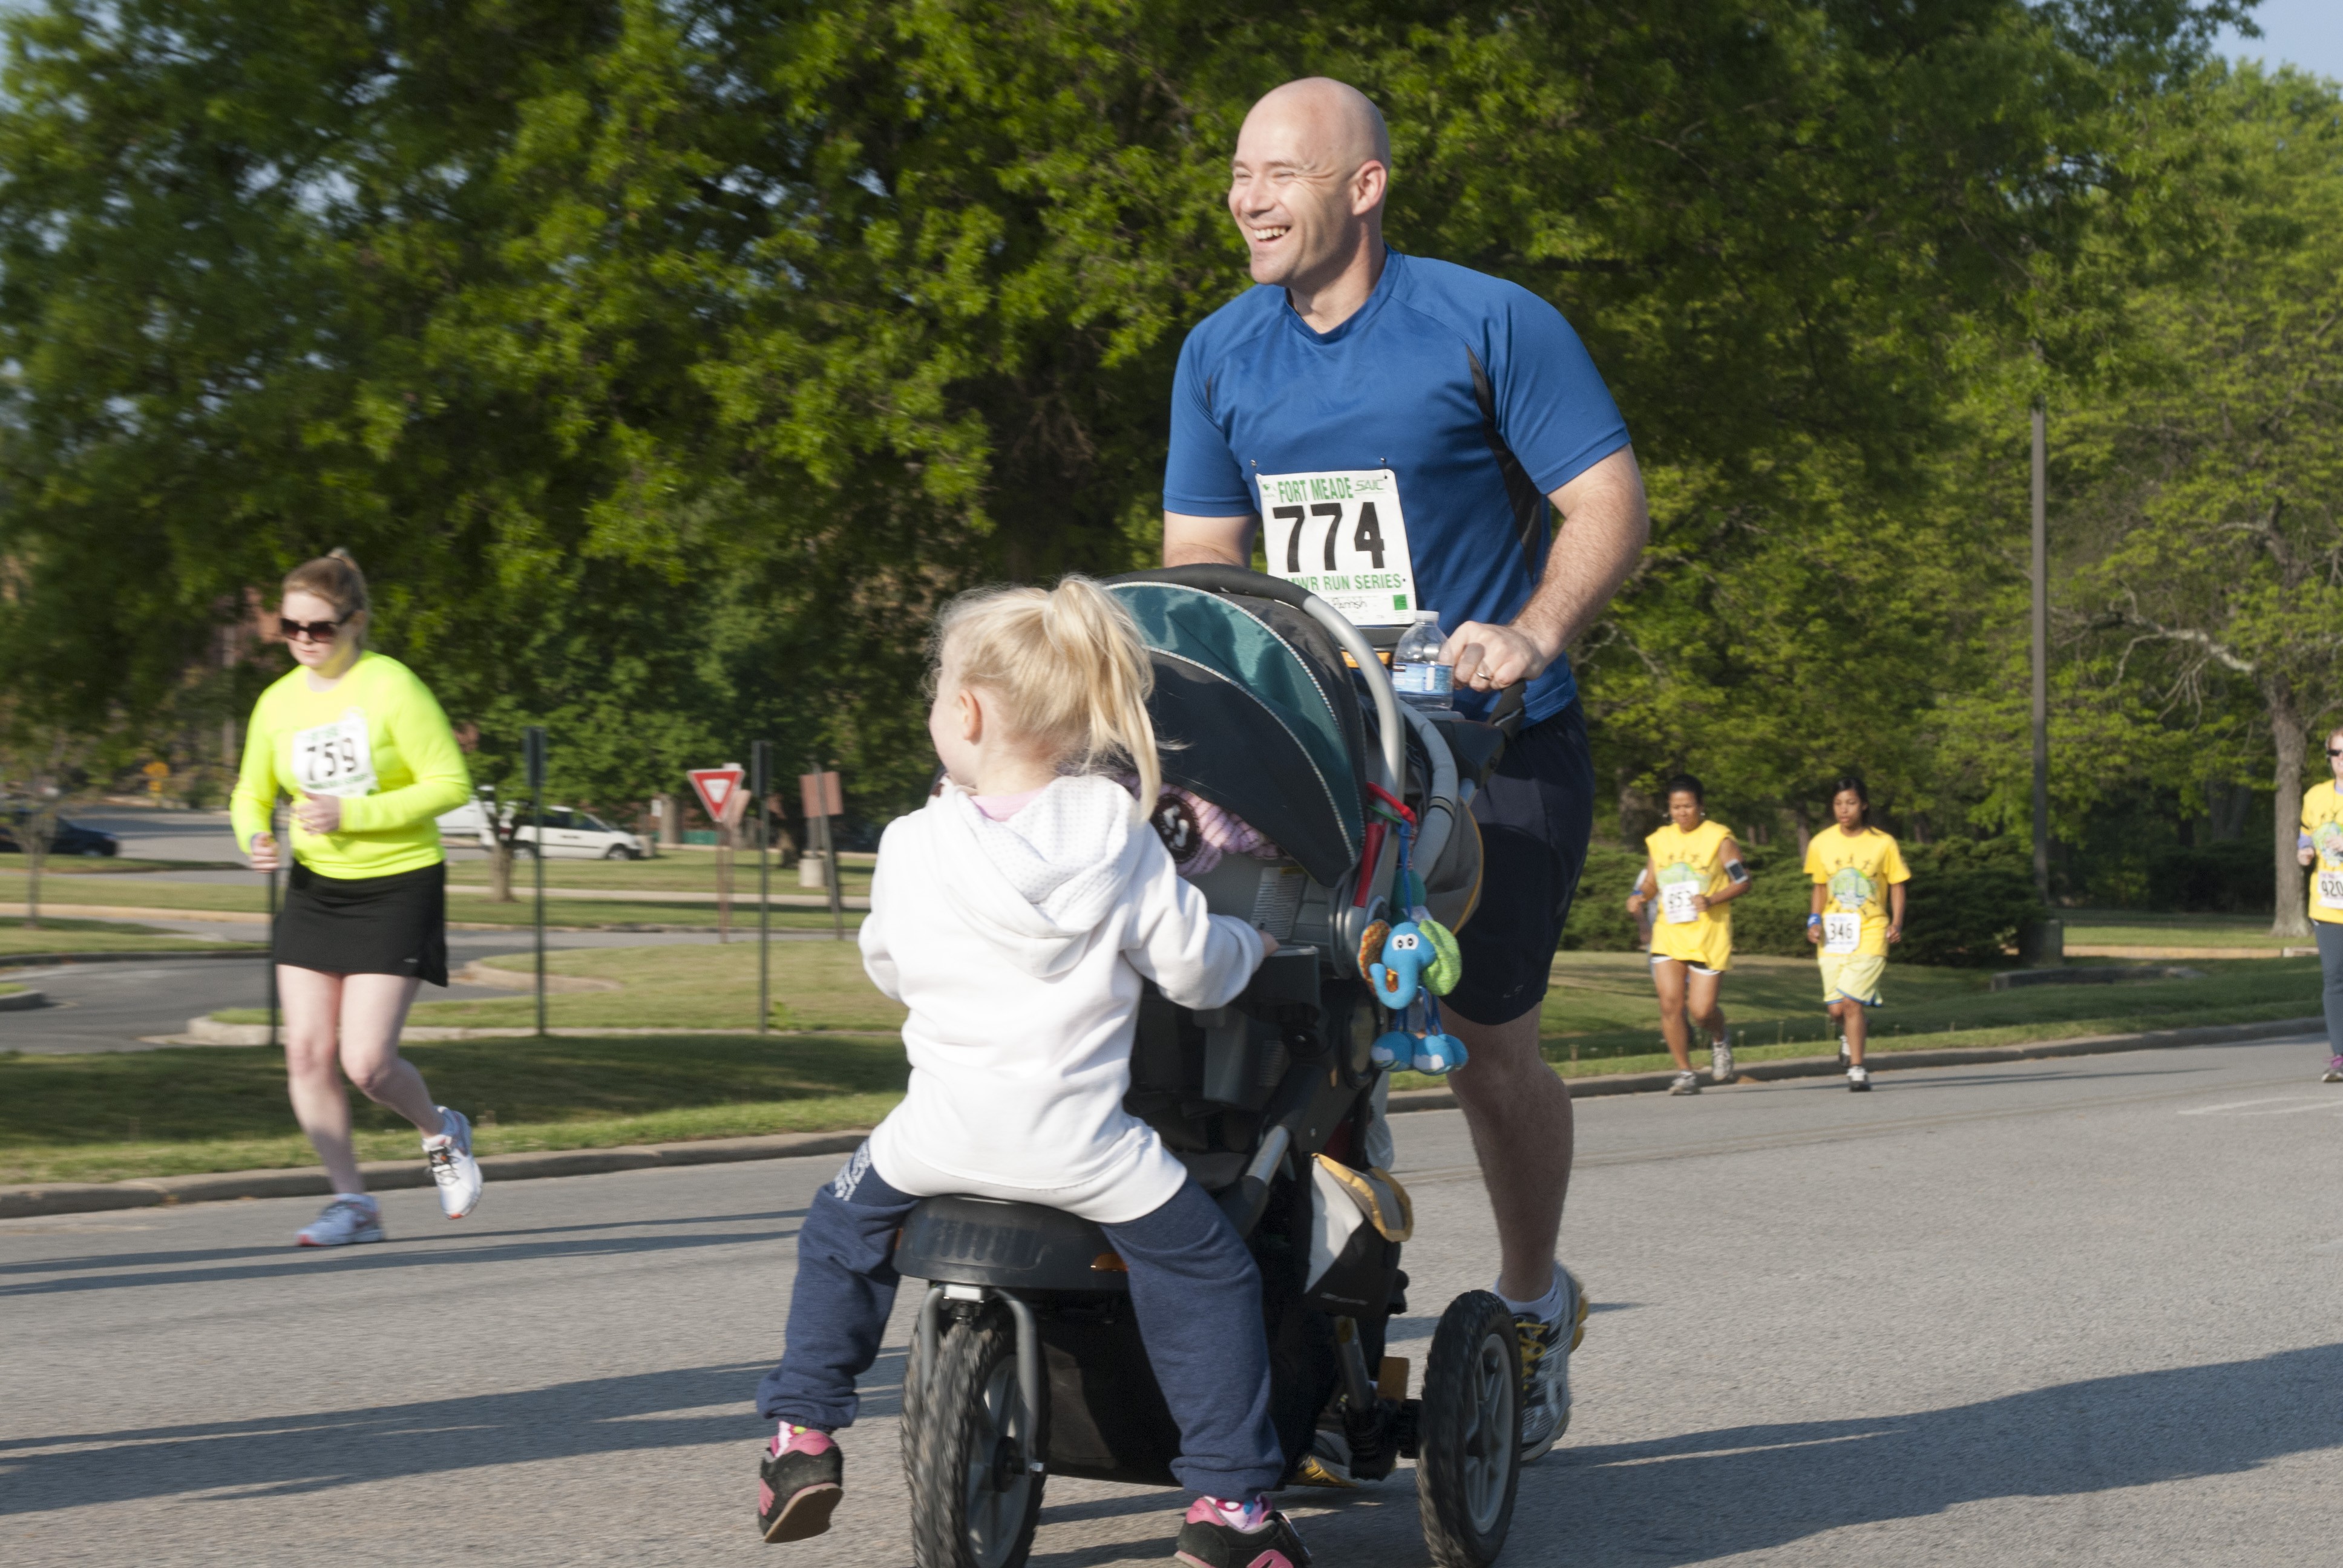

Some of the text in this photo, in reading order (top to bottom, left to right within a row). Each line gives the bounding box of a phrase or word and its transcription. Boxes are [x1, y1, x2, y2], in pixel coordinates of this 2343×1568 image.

[1277, 477, 1354, 503] FORT MEADE
[1273, 501, 1385, 573] 774
[1285, 573, 1402, 591] WR RUN SERIES
[306, 737, 356, 781] 759
[1829, 923, 1853, 940] 346
